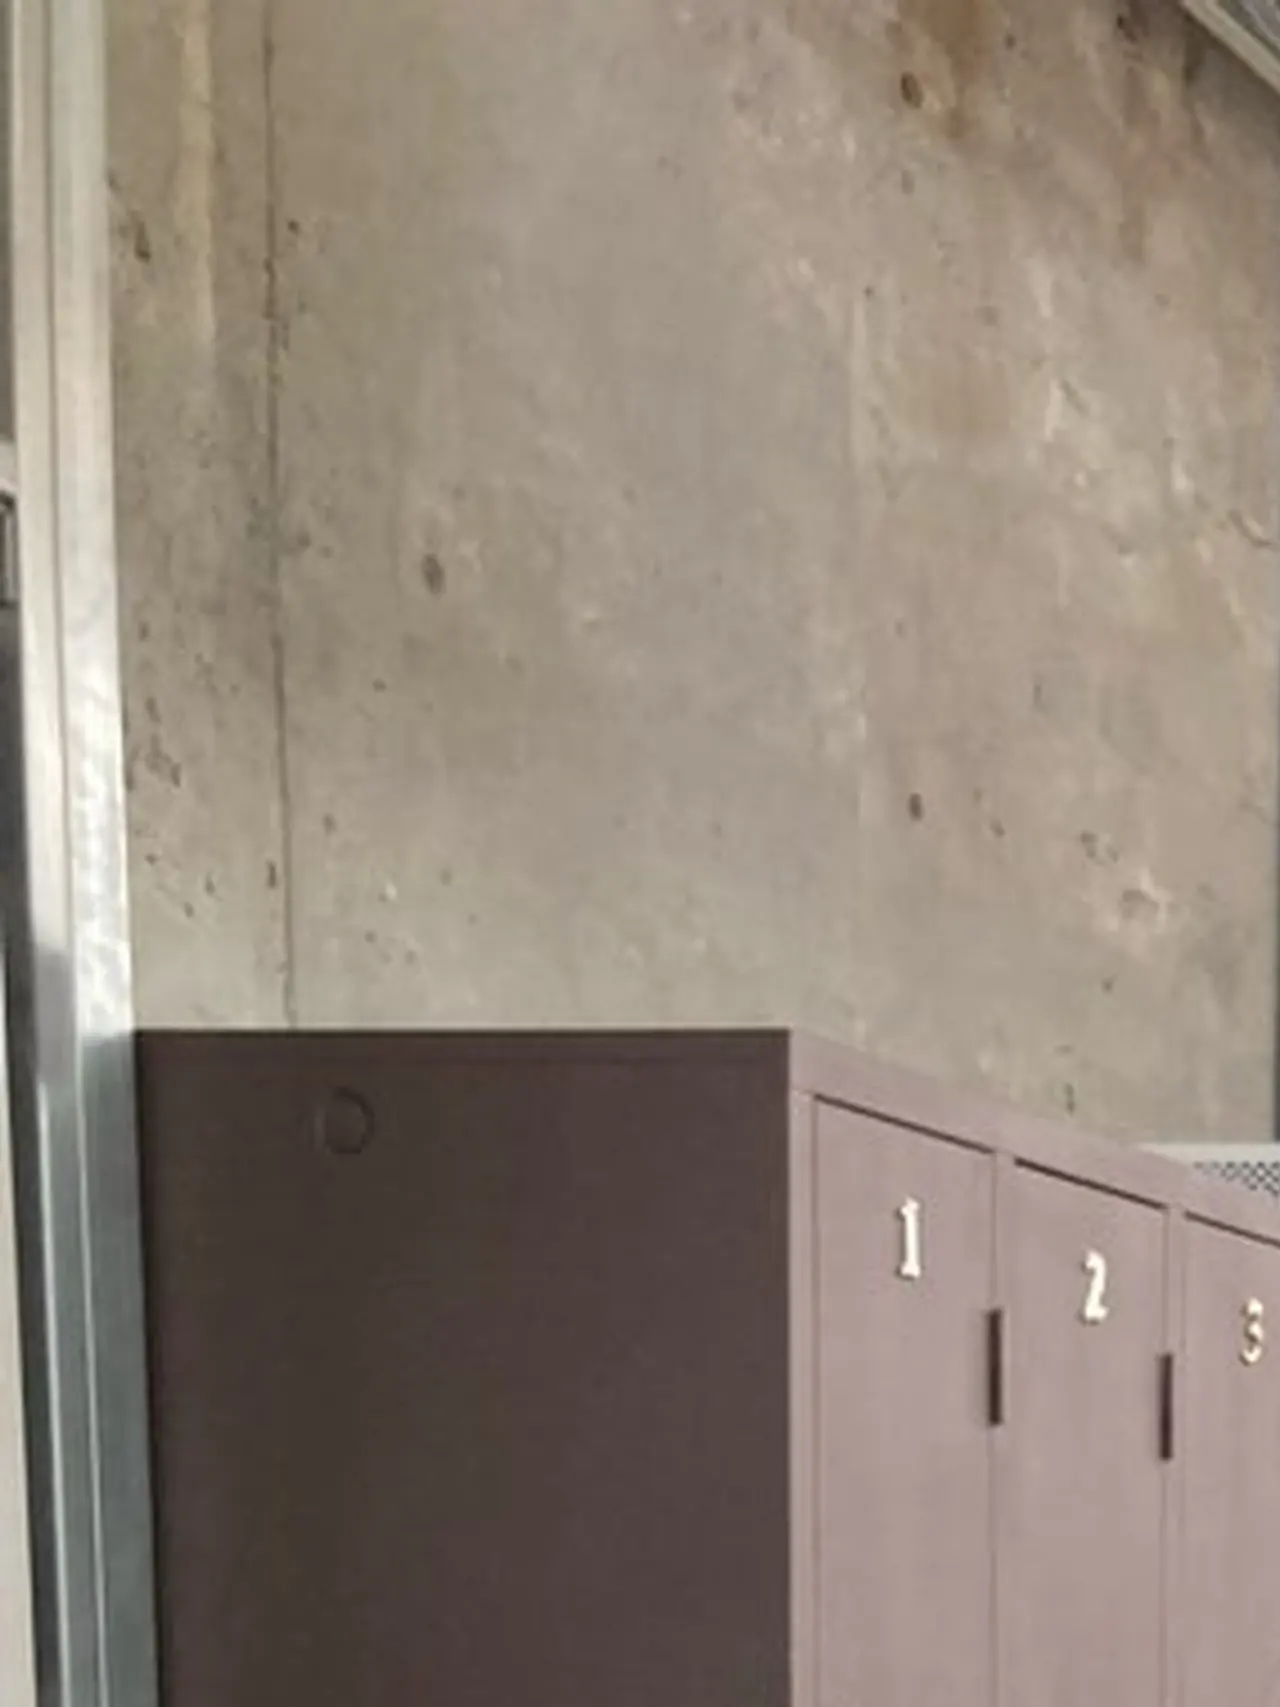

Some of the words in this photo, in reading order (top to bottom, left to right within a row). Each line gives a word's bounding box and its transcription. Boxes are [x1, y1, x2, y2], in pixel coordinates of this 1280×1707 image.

[900, 1197, 921, 1278] 1
[1084, 1249, 1109, 1322] 2
[1241, 1297, 1265, 1365] 3
